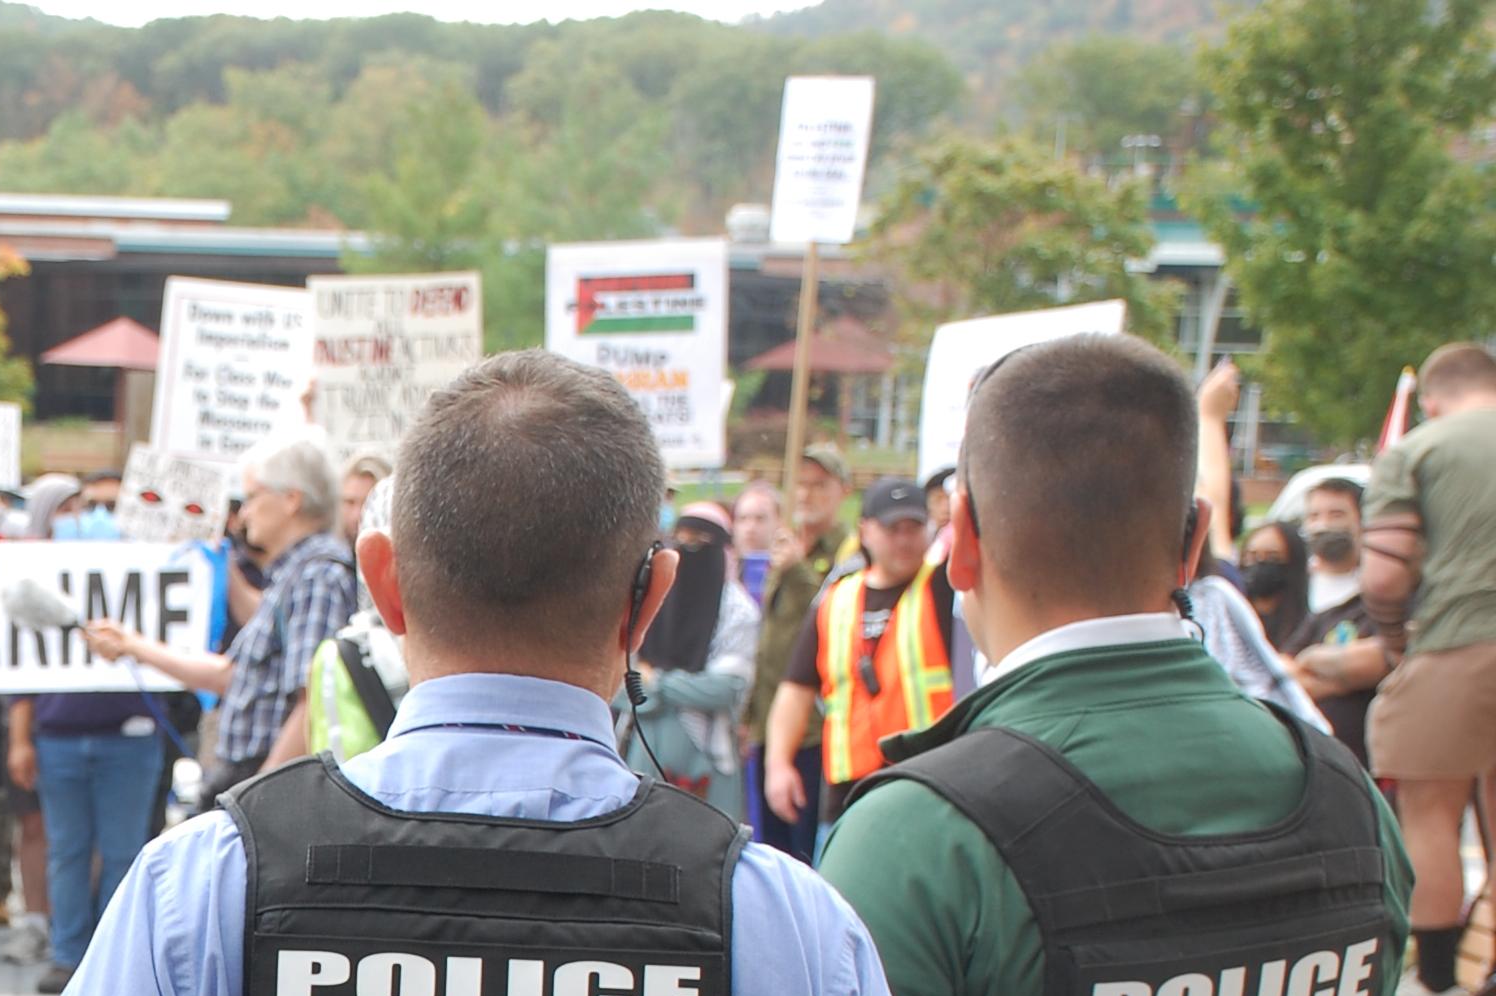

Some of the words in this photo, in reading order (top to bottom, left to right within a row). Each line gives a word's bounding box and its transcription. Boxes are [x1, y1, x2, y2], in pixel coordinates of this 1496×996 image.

[188, 301, 235, 323] Down
[240, 309, 276, 328] with
[316, 289, 377, 319] UNITE
[196, 327, 291, 351] Imperialism
[596, 342, 671, 367] DUMP
[184, 360, 209, 381] For
[215, 362, 257, 387] Class
